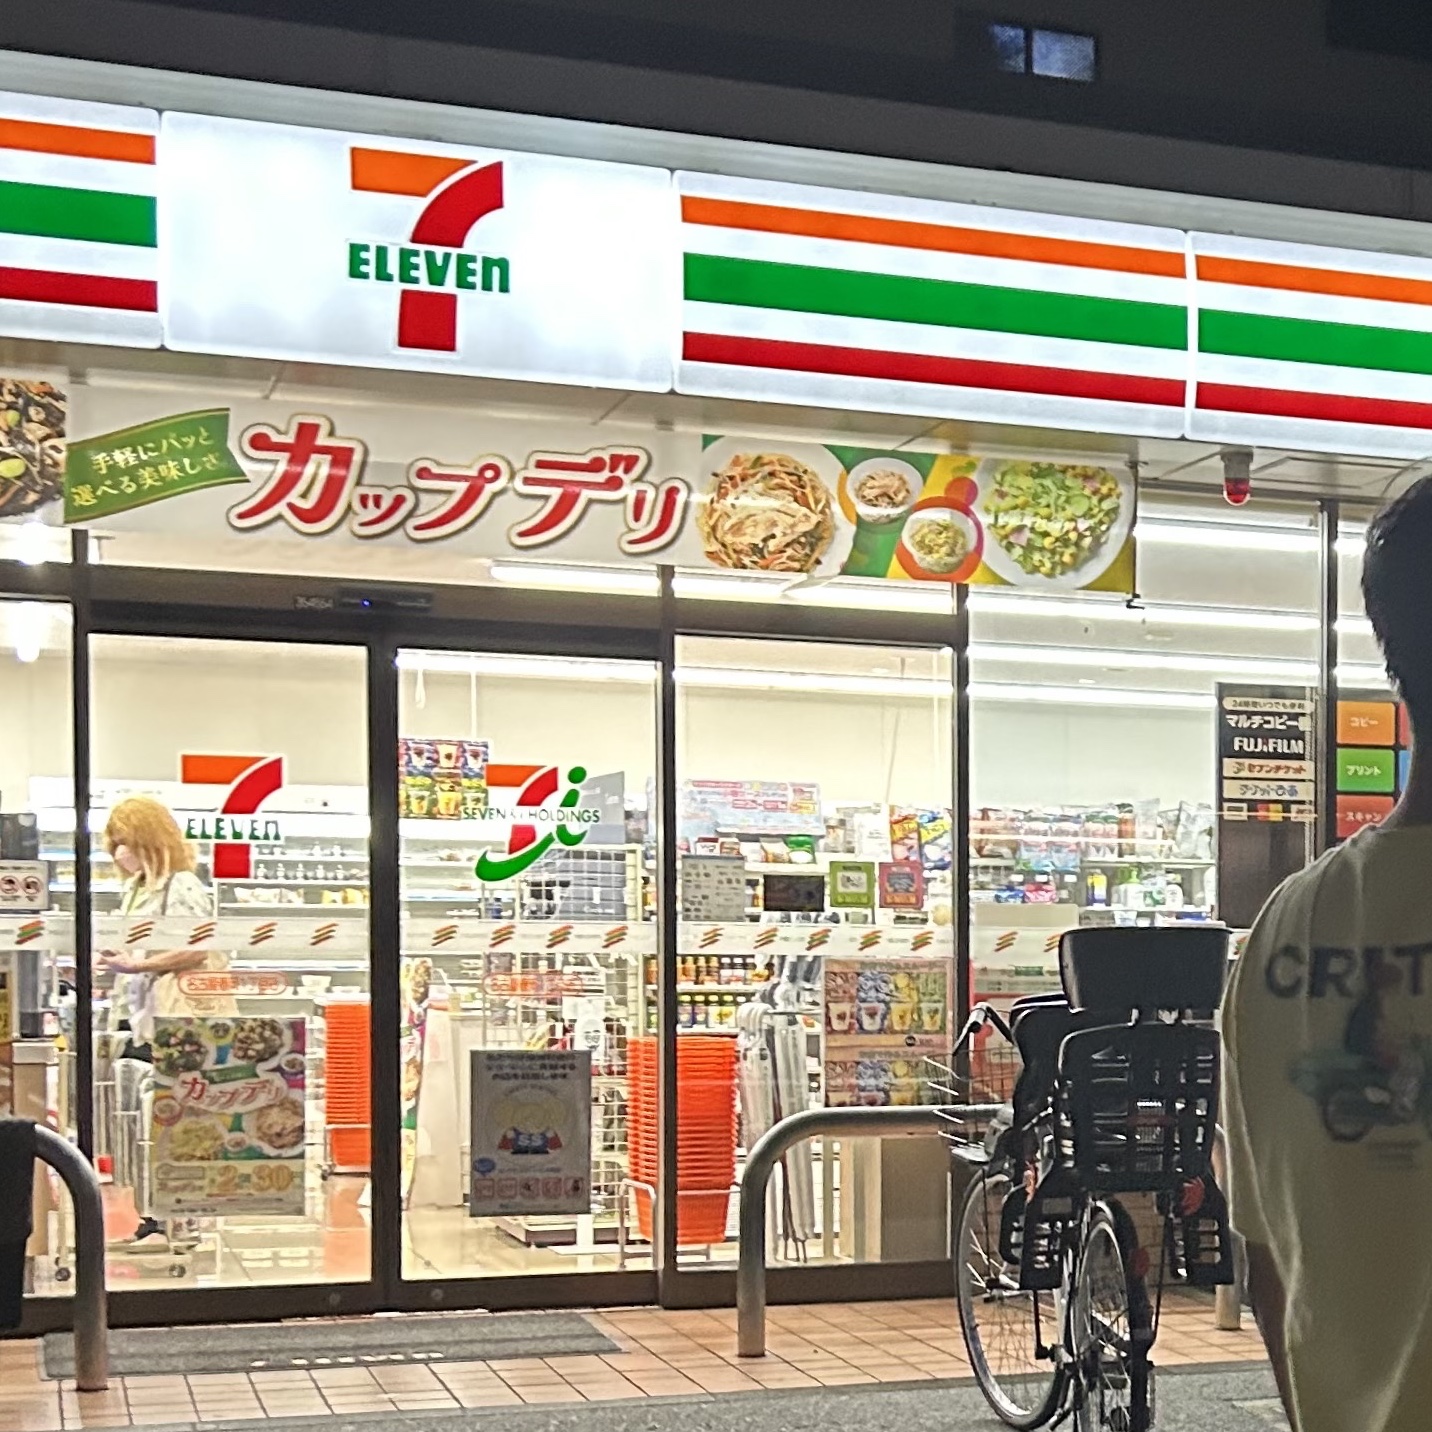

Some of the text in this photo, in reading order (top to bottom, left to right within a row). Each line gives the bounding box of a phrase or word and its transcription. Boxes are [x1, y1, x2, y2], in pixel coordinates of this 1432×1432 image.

[91, 426, 214, 474] 手軽にパッと
[235, 421, 684, 548] カップデリ
[1225, 714, 1311, 731] マルチコピー
[1350, 717, 1379, 727] コピー
[1346, 765, 1381, 776] プリント
[463, 807, 507, 820] SEVEN
[528, 808, 601, 823] HOLDINGS
[1345, 811, 1382, 822] スキャン
